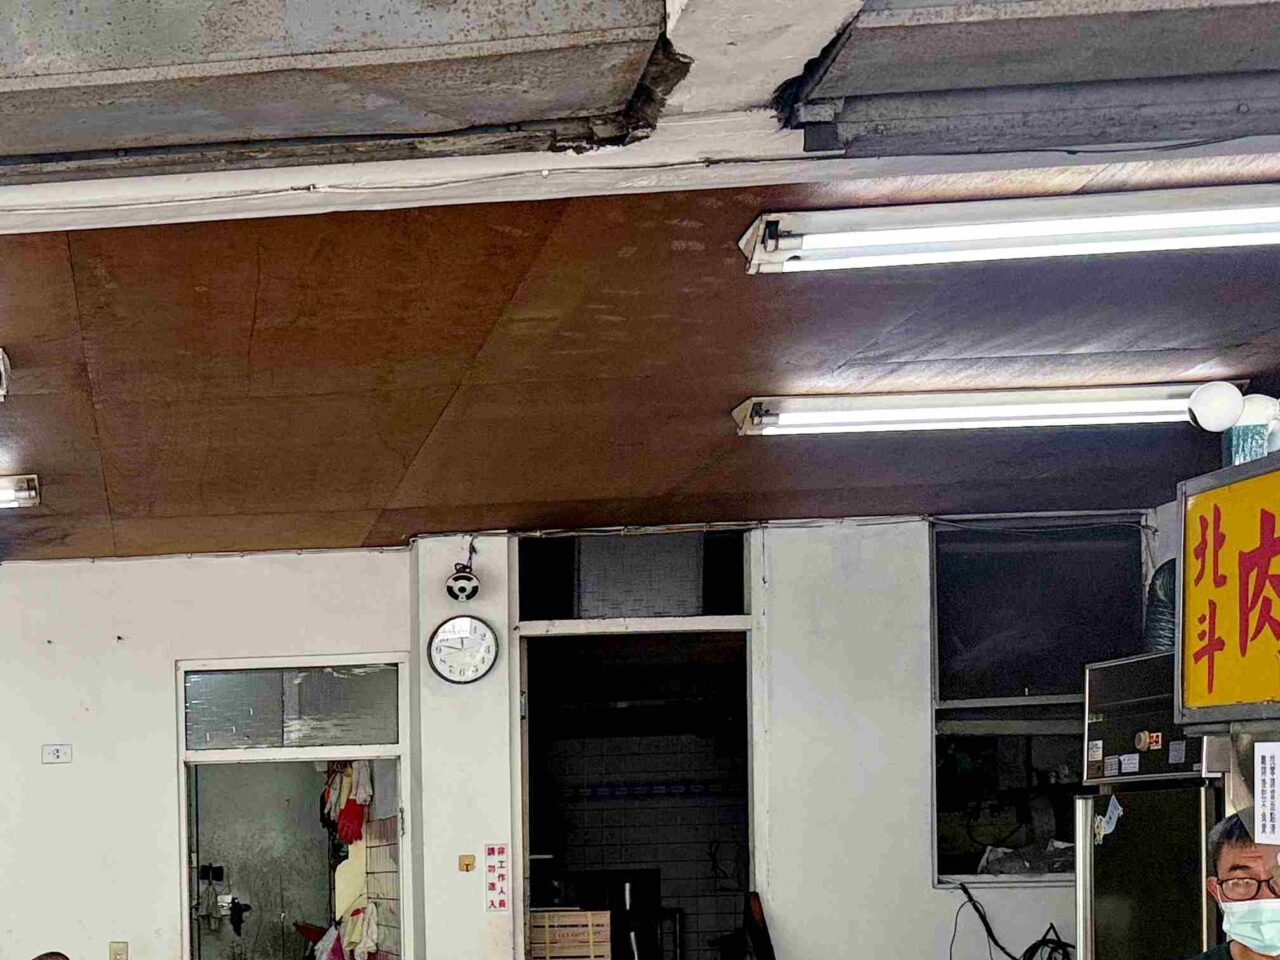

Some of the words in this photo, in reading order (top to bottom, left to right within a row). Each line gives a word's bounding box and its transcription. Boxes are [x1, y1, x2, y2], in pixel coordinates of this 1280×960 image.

[1193, 503, 1226, 694] 北斗
[487, 846, 497, 909] 請勿進入
[497, 846, 507, 909] 非工作人員
